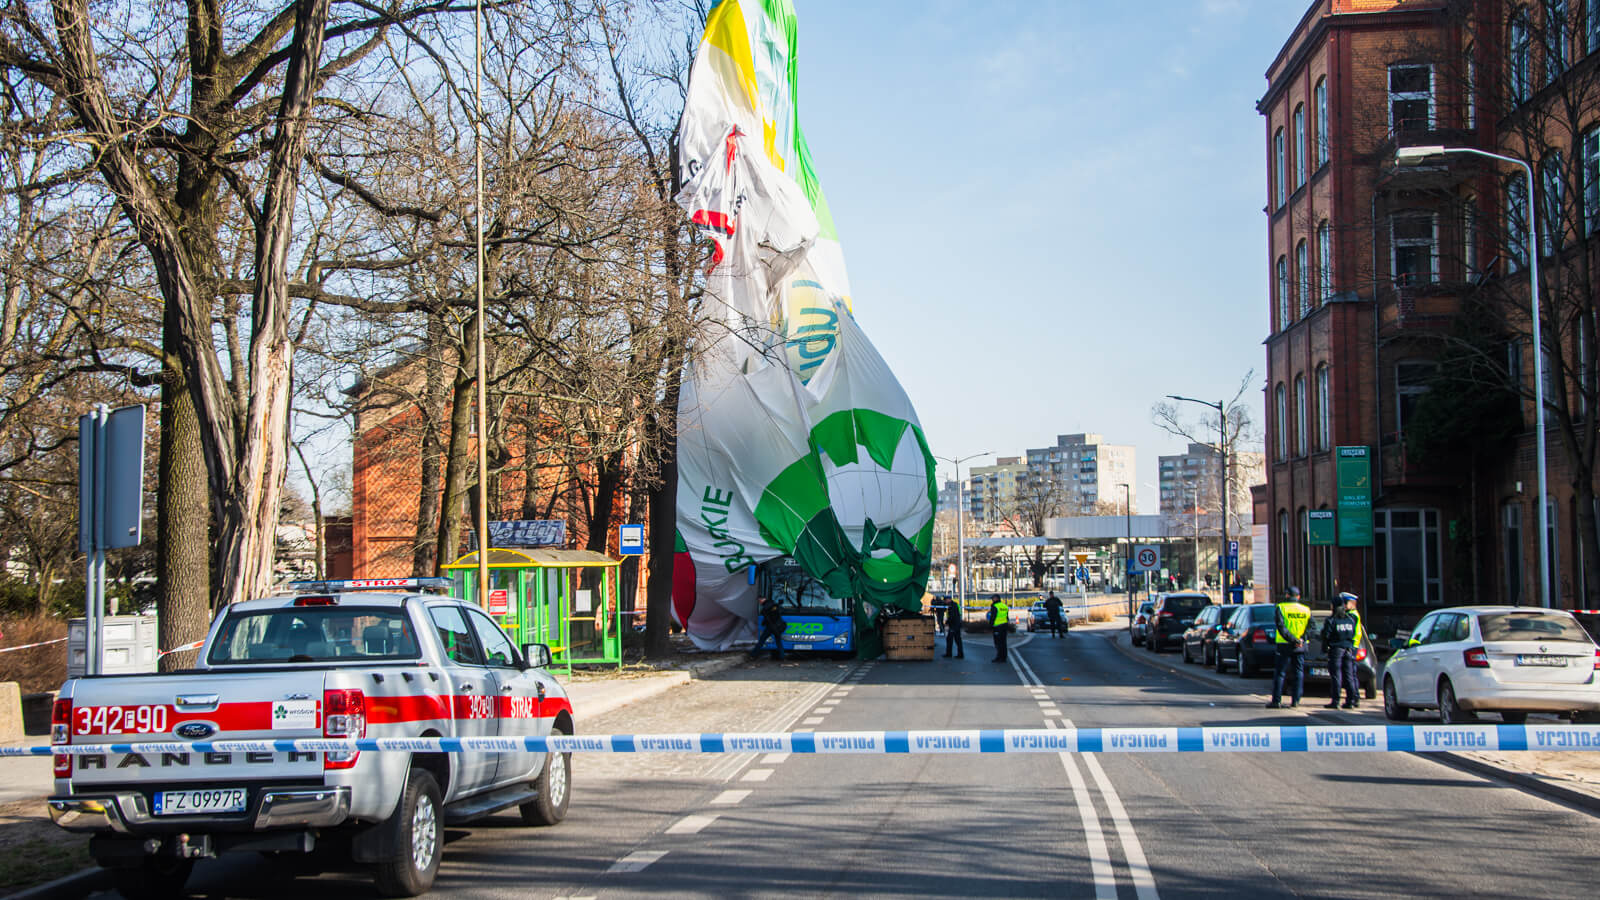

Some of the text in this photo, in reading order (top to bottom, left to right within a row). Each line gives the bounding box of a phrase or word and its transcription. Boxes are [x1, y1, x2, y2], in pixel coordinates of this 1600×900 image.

[1230, 543, 1237, 551] P
[1142, 553, 1153, 562] 30
[554, 738, 603, 750] POLICJA
[641, 738, 692, 750] POLICJA
[730, 737, 782, 750] POLICJA
[822, 737, 875, 749] POLICJA
[916, 736, 970, 748] POLICJA
[1012, 735, 1067, 748] POLICJA
[1111, 734, 1167, 747] POLICJA
[1212, 732, 1270, 747] POLICJA
[1316, 732, 1376, 746] POLICJA
[1424, 731, 1486, 746] POLICJA
[383, 741, 431, 750] POLICJA
[468, 740, 516, 750] POLICJA
[165, 790, 242, 809] FZ 0997R
